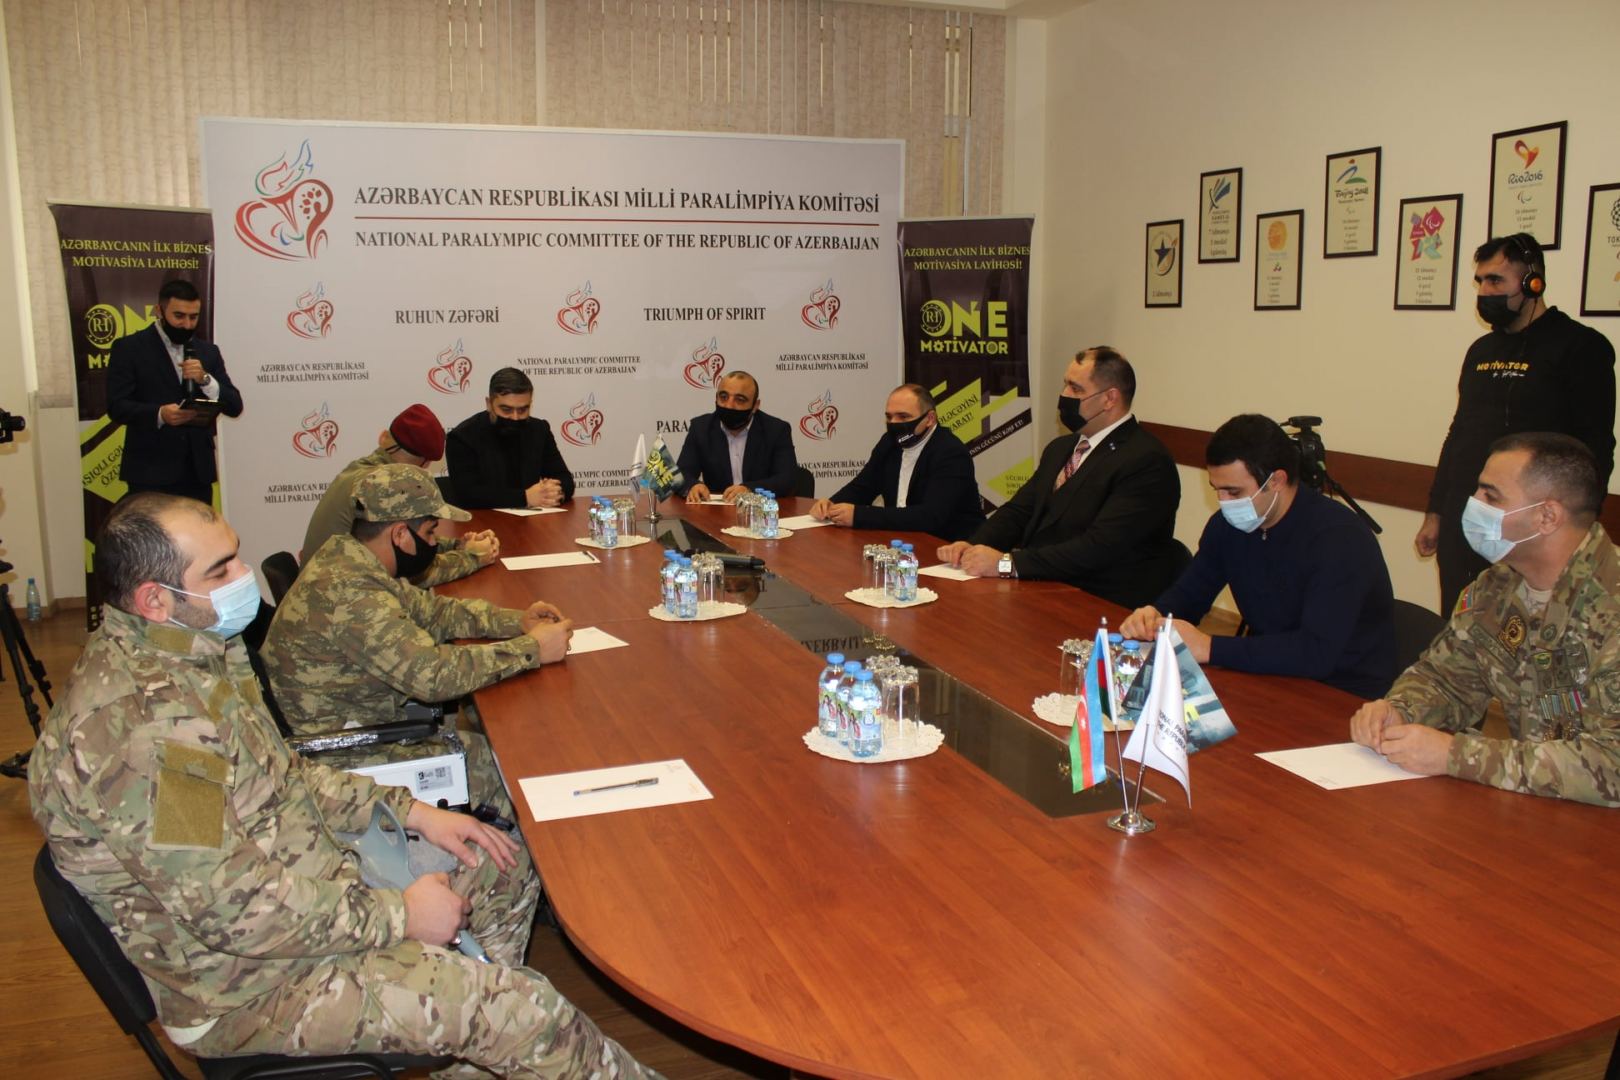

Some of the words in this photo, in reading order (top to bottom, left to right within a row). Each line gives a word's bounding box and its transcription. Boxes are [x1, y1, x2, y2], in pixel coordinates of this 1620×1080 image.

[354, 187, 483, 206] AZƏRBAYCAN
[489, 186, 619, 207] RESPUBLİKASI
[624, 187, 675, 208] MİLLİ
[680, 189, 795, 211] PARALİMPİYA
[799, 191, 879, 213] KOMİTƏSİ
[355, 231, 439, 247] NATIONAL
[442, 232, 542, 248] PARALYMPIC
[546, 233, 640, 248] COMMITTEE
[643, 233, 663, 248] OF
[666, 233, 696, 248] THE
[699, 234, 770, 249] REPUBLIC
[773, 235, 793, 249] OF
[794, 235, 880, 250] AZERBAIJAN
[1607, 235, 1620, 244] TOK
[61, 240, 151, 252] AZƏRBAYCANIN
[153, 240, 172, 253] İLK
[173, 240, 213, 255] BİZNES
[904, 247, 978, 257] AZƏRBAYCANIN
[980, 245, 996, 256] İLK
[998, 244, 1031, 256] BİZNES
[72, 254, 145, 268] MOTİVASİYA
[147, 256, 200, 269] LAYİHƏSİ!
[914, 260, 972, 271] MOTİVASİYA
[974, 258, 1023, 270] LAYİHƏSİ!
[395, 309, 445, 324] RUHUN
[448, 306, 499, 324] ZƏFƏRİ
[644, 307, 704, 321] TRIUMPH
[706, 307, 723, 321] OF
[726, 307, 766, 321] SPIRIT
[920, 299, 1008, 338] ONE
[85, 304, 158, 349] ON
[517, 358, 551, 366] NATIONAL
[554, 356, 597, 365] PARALYMPIC
[599, 356, 641, 364] COMMITTEE
[779, 353, 821, 362] AZƏRBAYCAN
[821, 352, 866, 361] RESPUBLİKASI
[260, 364, 311, 373] AZƏRBAYCAN
[312, 361, 365, 371] RESPUBLİKASI
[534, 367, 548, 375] THE
[549, 366, 583, 375] REPUBLIC
[584, 366, 594, 374] OF
[594, 365, 637, 374] AZERBAIJAN
[776, 363, 794, 371] MİLLİ
[795, 362, 837, 371] PARALİMPİYA
[838, 361, 869, 370] KOMİTƏSİ
[256, 373, 279, 383] MİLLİ
[280, 372, 331, 382] PARALİMPİYA
[332, 371, 369, 381] KOMİTƏSİ
[938, 394, 979, 424] ƏLƏCƏYİNİ
[656, 419, 689, 433] PARA
[951, 412, 973, 431] ARAT!
[571, 471, 600, 479] LYMPIC
[602, 469, 632, 477] COMMIT
[815, 469, 837, 478] İMPİYA
[838, 469, 858, 477] KOMİT
[268, 483, 317, 493] AZƏRBAYCAN
[587, 480, 596, 488] OF
[598, 480, 630, 488] AZERBAI
[264, 493, 286, 504] MİLLİ
[288, 493, 322, 502] PARALİM
